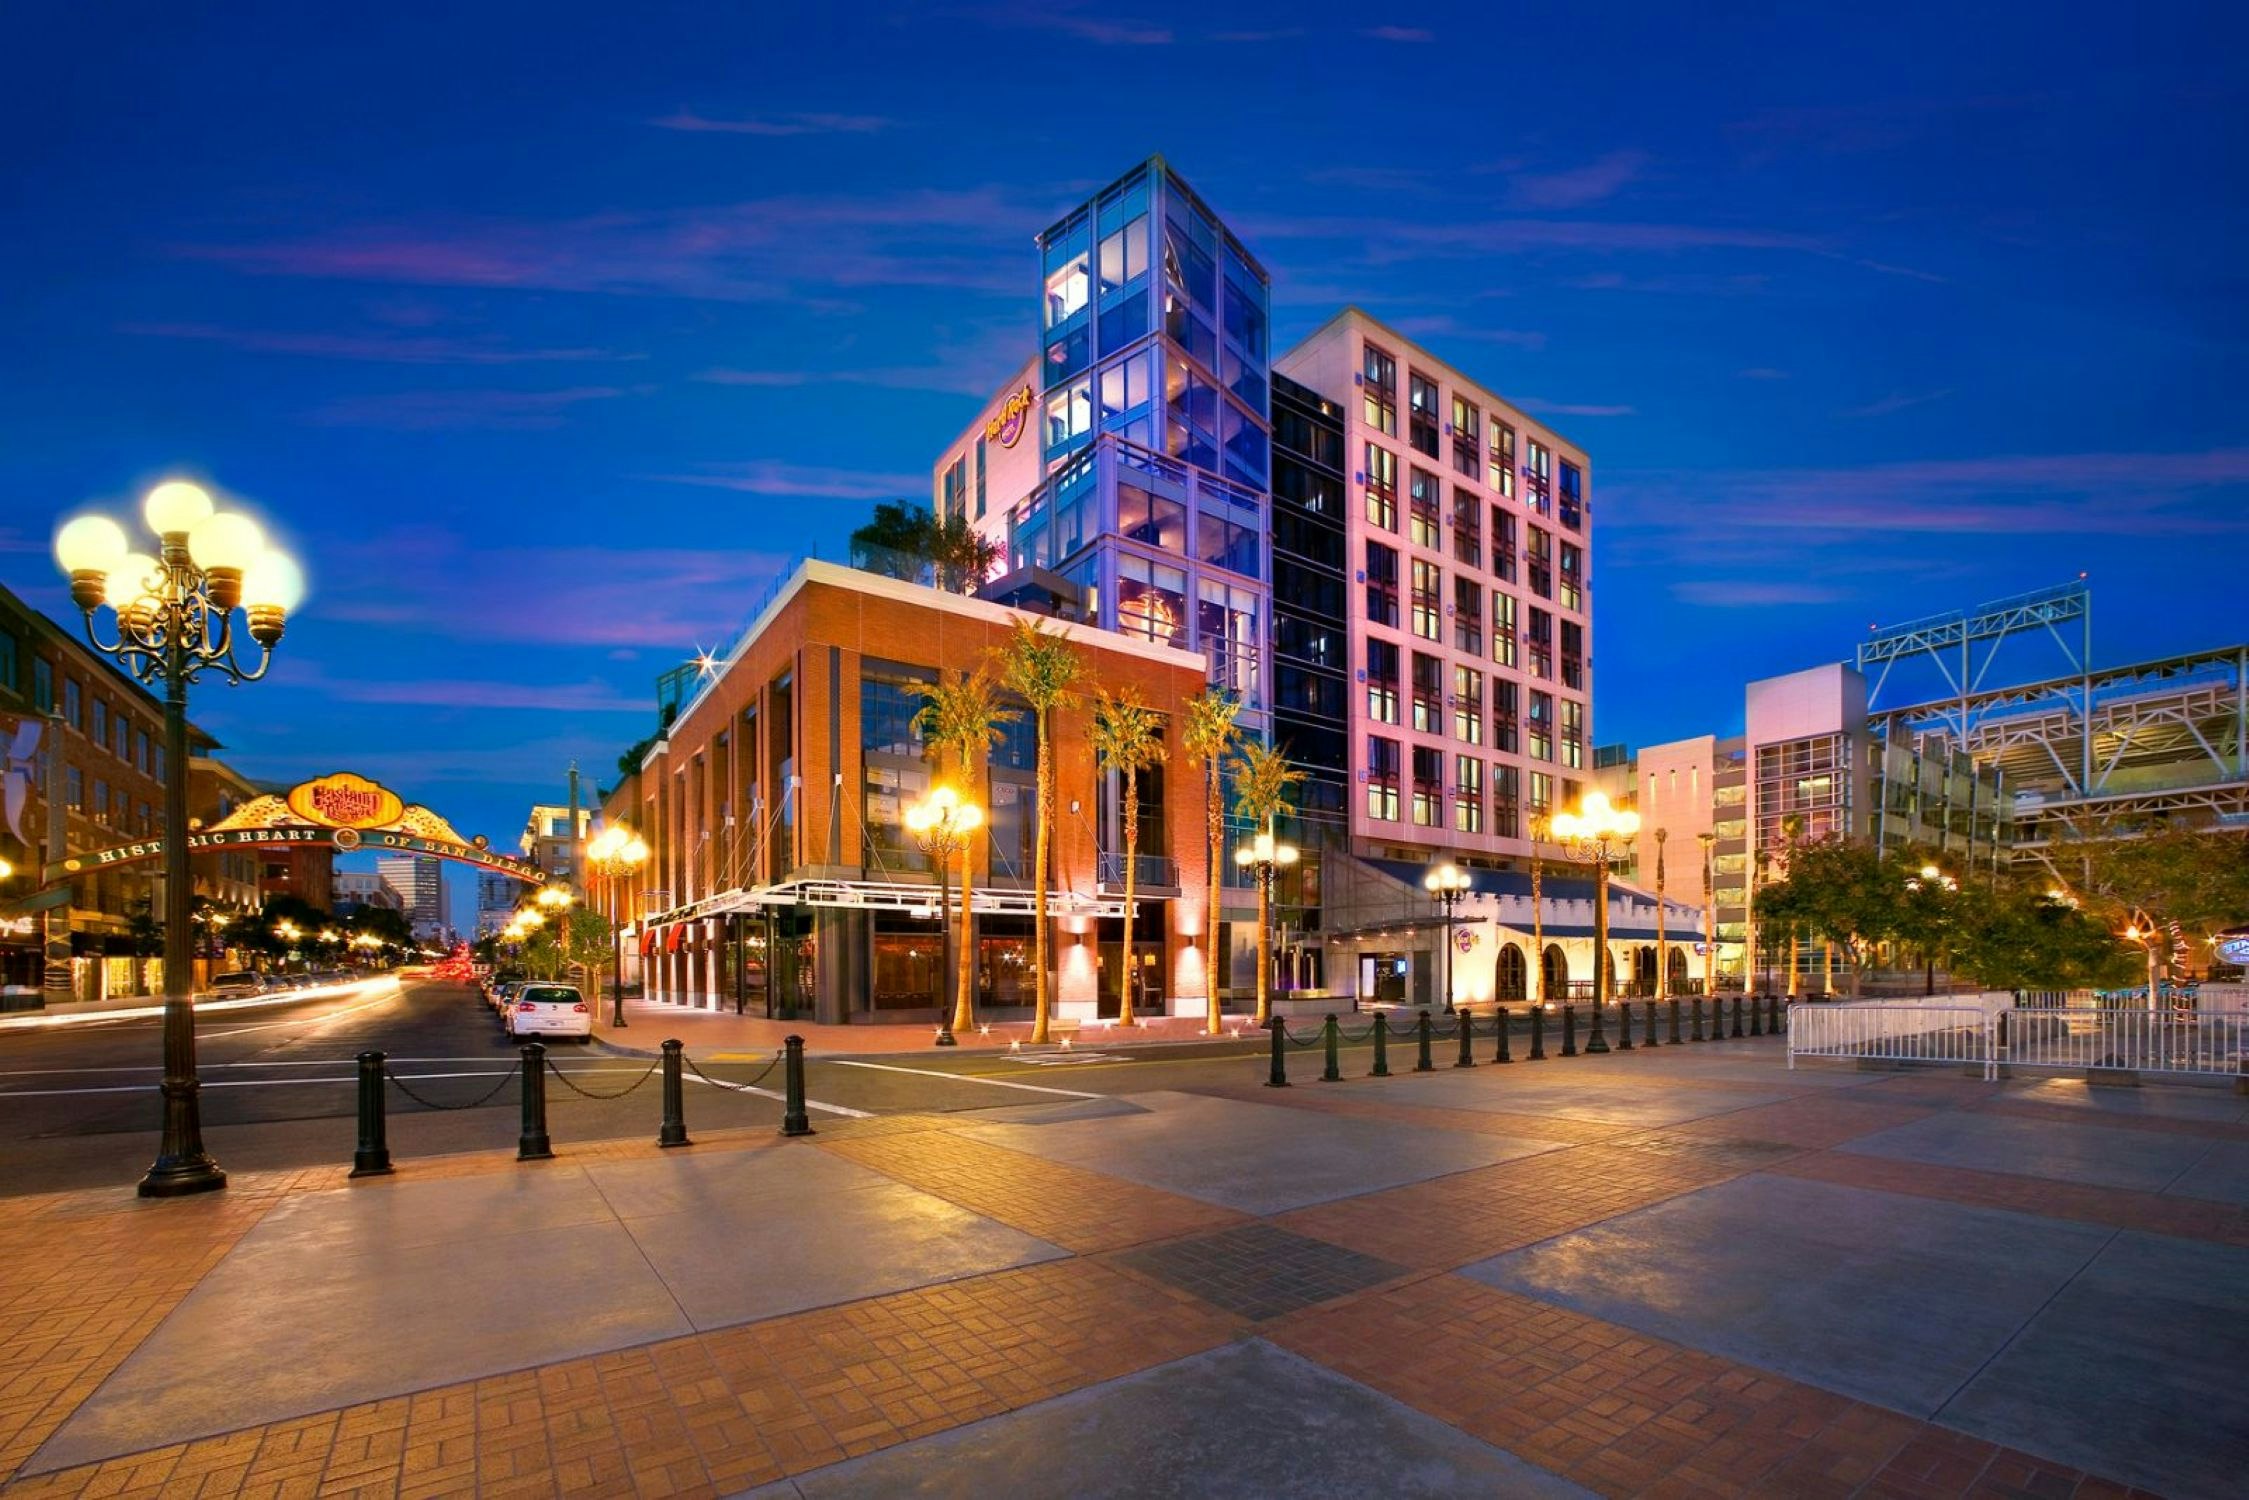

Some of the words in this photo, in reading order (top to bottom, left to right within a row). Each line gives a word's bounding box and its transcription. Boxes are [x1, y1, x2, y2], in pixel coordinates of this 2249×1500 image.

[98, 833, 226, 864] HISTRIC
[239, 830, 315, 843] HEART
[384, 835, 410, 847] OF
[424, 840, 467, 858] SAN
[481, 854, 546, 882] DIEGO
